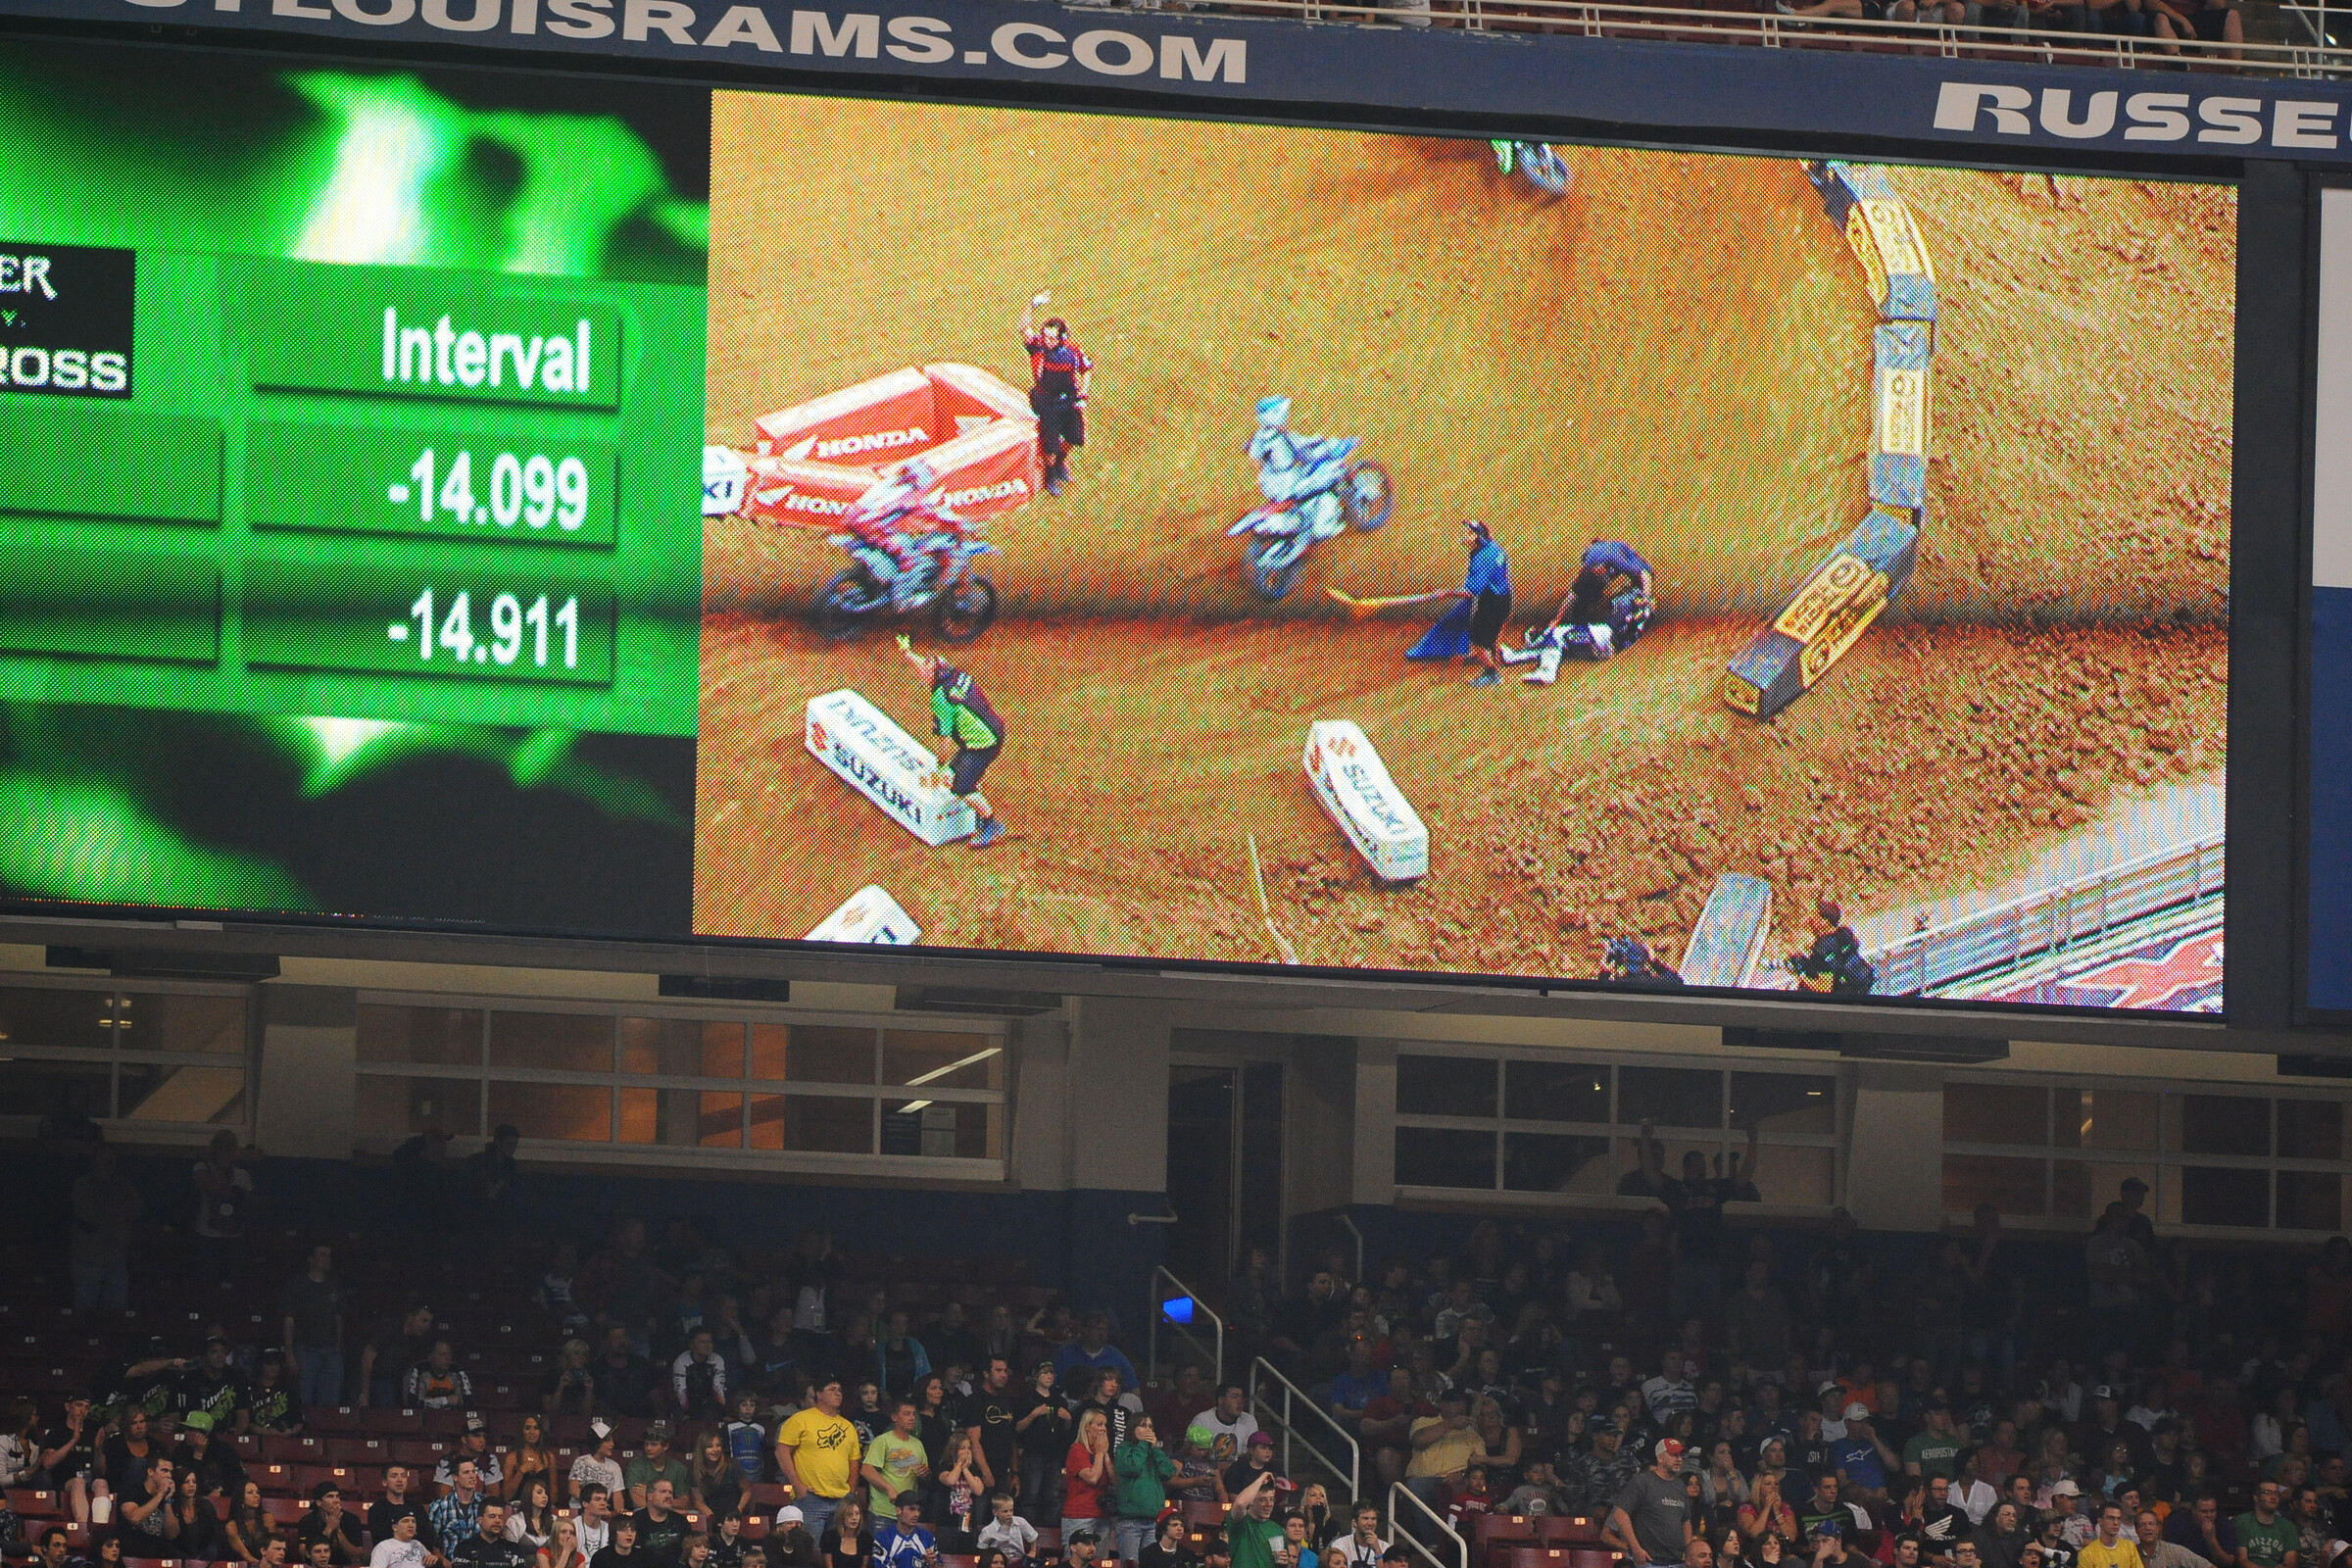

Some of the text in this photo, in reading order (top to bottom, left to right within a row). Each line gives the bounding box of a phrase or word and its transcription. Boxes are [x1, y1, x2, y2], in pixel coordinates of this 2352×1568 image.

[115, 0, 1247, 83] LOUISRAMS.COM
[1934, 82, 2352, 150] RUSSE
[382, 307, 591, 393] Interval
[817, 428, 931, 459] HONDA
[387, 448, 589, 531] -14.099
[943, 477, 1029, 509] HONDA
[387, 586, 580, 669] -14.911
[833, 743, 922, 824] SUZUKI
